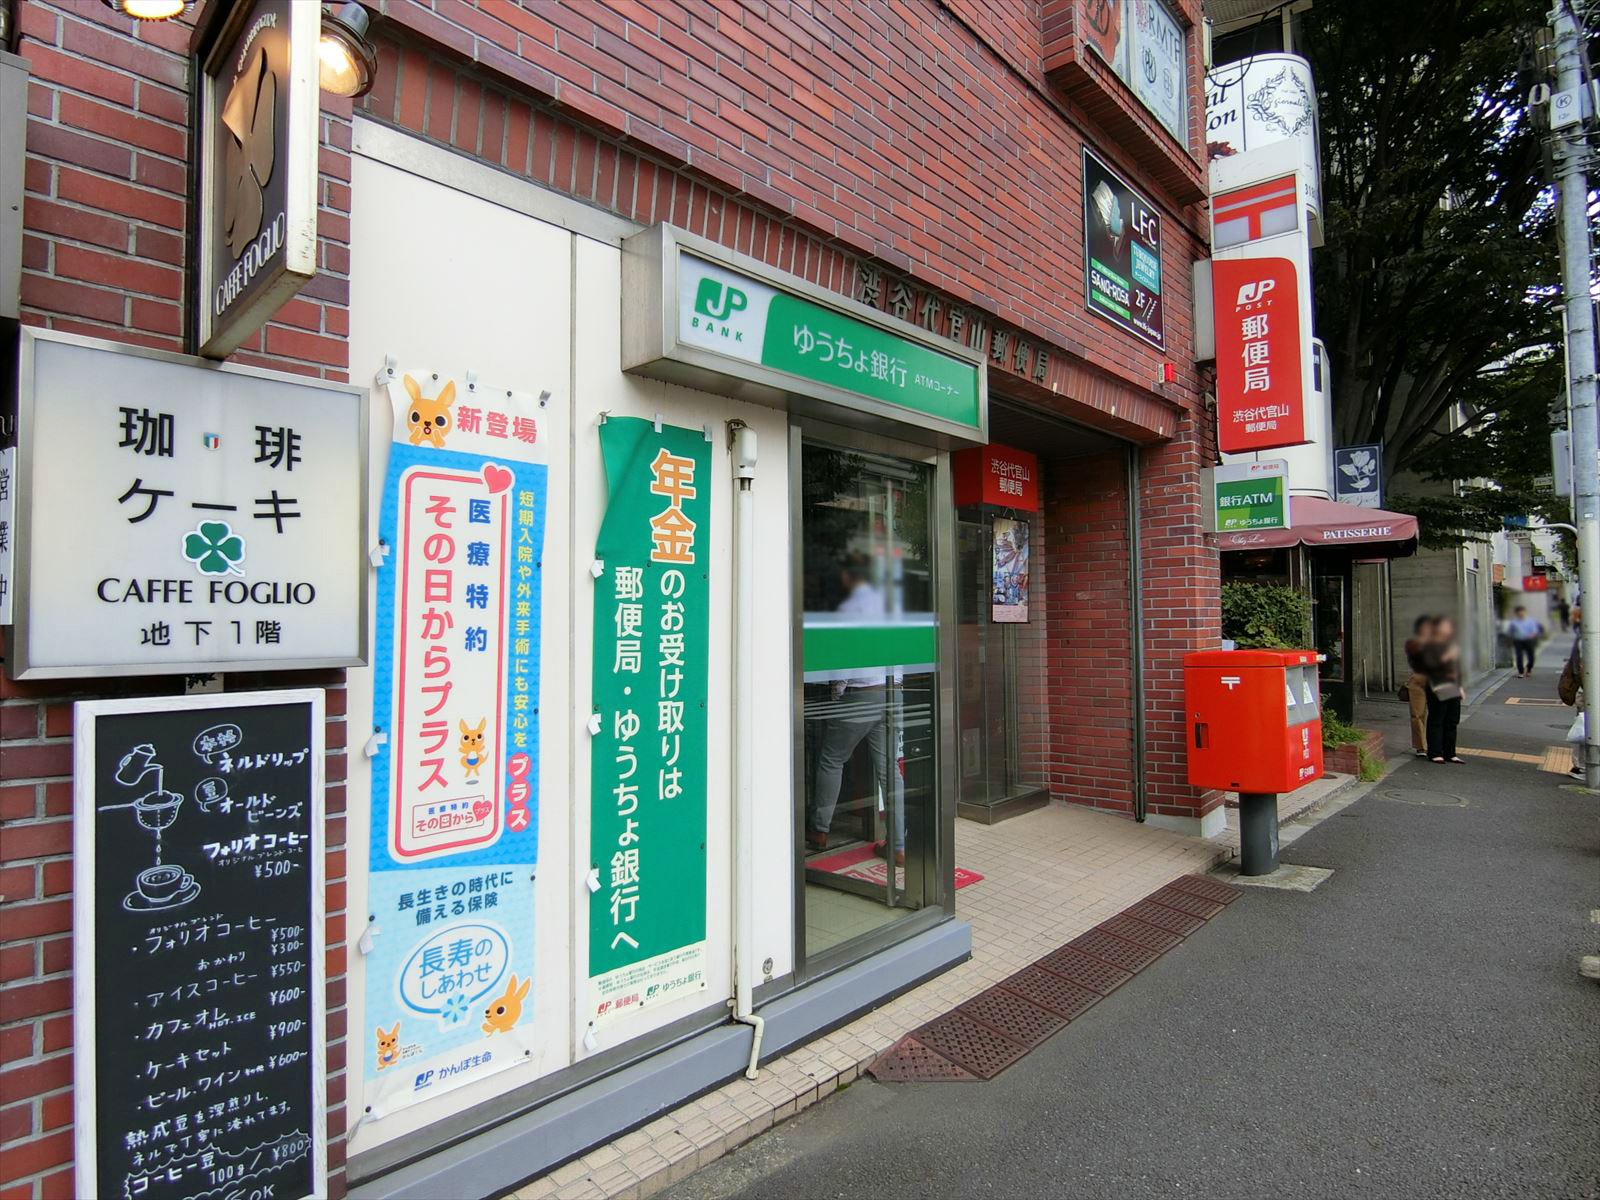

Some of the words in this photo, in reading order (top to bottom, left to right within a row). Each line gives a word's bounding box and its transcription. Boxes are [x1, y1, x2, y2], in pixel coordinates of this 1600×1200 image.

[1131, 202, 1157, 245] LFC
[216, 263, 243, 316] CAFFE
[243, 212, 285, 287] FOGLIO
[857, 262, 1050, 382] 渋谷代官山郵便局
[1236, 300, 1273, 313] POST
[691, 317, 744, 343] BANK
[793, 324, 908, 388] ゆうちょ銀行
[914, 373, 961, 396] ATMコーナー
[1241, 314, 1270, 394] 郵便局
[457, 405, 538, 444] 新登場
[1233, 404, 1289, 423] 渋谷代官山
[1245, 422, 1277, 433] 郵便局
[119, 407, 301, 471] 珈琲
[991, 458, 1030, 481] 渋谷代官山
[999, 477, 1022, 496] 郵便局
[118, 478, 301, 534] ケーキ
[1219, 492, 1273, 507] 銀行ATM
[1323, 526, 1392, 540] PATISSERIE
[97, 578, 193, 603] CAFFE
[209, 581, 316, 605] FOGLIO
[464, 499, 491, 652] 医療特約
[141, 621, 281, 646] 地下1階
[514, 490, 535, 748] 短期入院や外来手術にも安心を
[650, 448, 696, 800] 年金のお受け取りは
[418, 495, 457, 792] その日からプラス
[220, 748, 309, 773] ネルドリップ
[610, 566, 643, 950] 郵便局・ゆうちょ銀行へ
[203, 781, 219, 800] 豆
[220, 793, 276, 814] オールド
[511, 756, 529, 828] プラス
[248, 801, 303, 823] ビーンズ
[416, 812, 474, 831] その日から
[398, 871, 514, 912] 長生きの時代に
[416, 892, 498, 926] 備える保険
[198, 951, 246, 970] おかわり
[419, 937, 493, 979] 長寿の
[147, 973, 258, 1007] アイスコーヒー
[420, 963, 493, 1000] しあわせ
[146, 1008, 226, 1039] カフェオレ
[147, 1042, 231, 1079] ケーキセット
[439, 1051, 492, 1080] かんぽ生命
[133, 1152, 215, 1194] コーヒー豆
